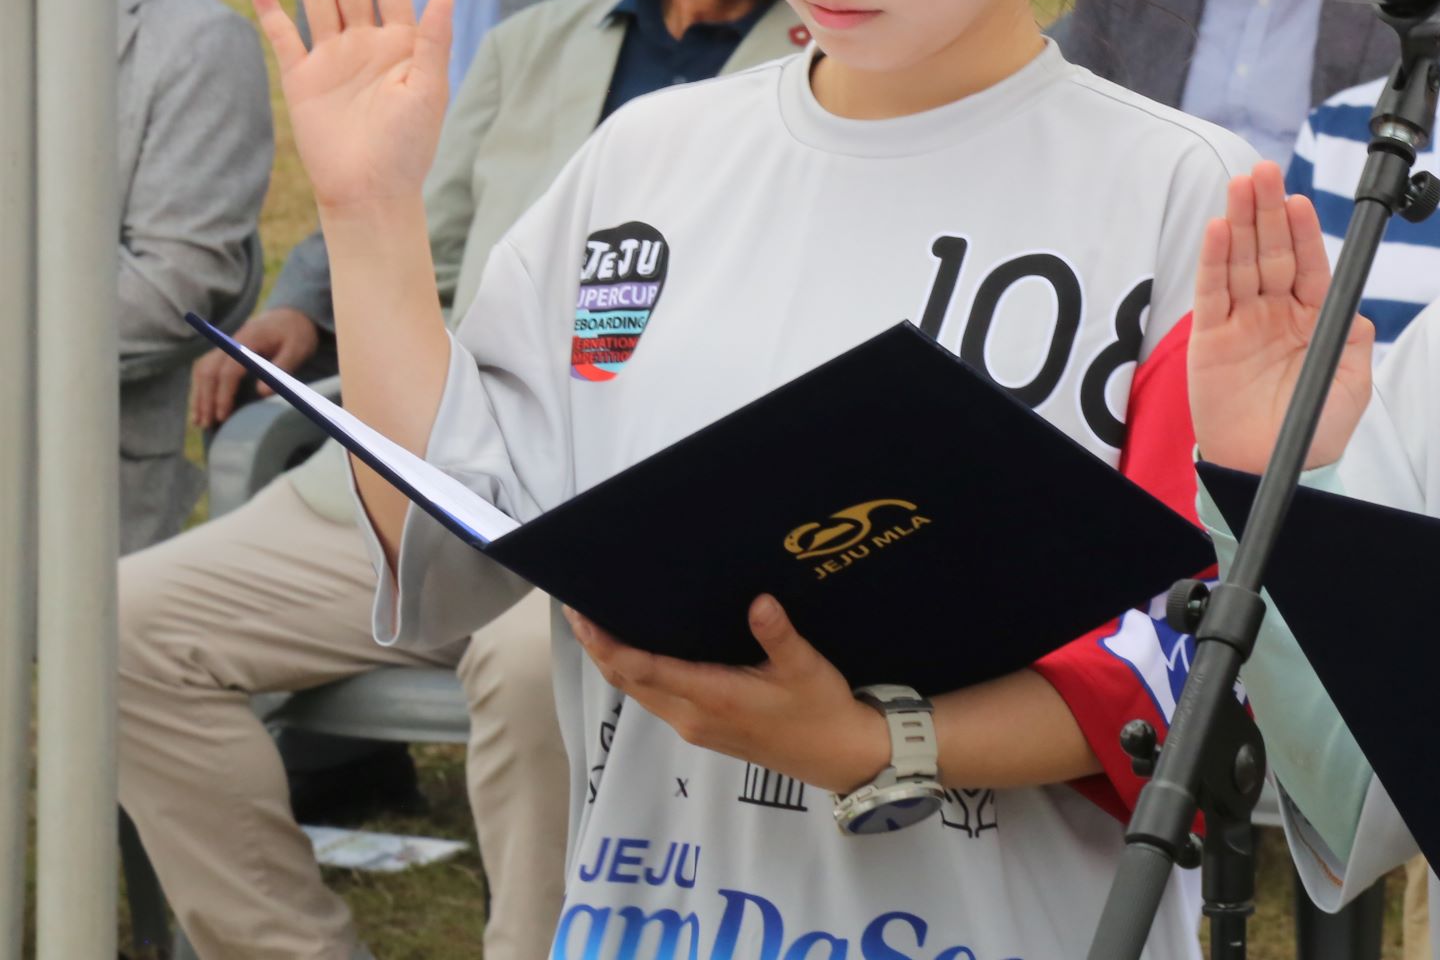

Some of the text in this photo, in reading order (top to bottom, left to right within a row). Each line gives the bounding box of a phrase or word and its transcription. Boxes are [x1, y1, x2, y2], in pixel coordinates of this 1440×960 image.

[814, 515, 932, 580] JEJU MLA
[579, 837, 701, 889] JEJU
